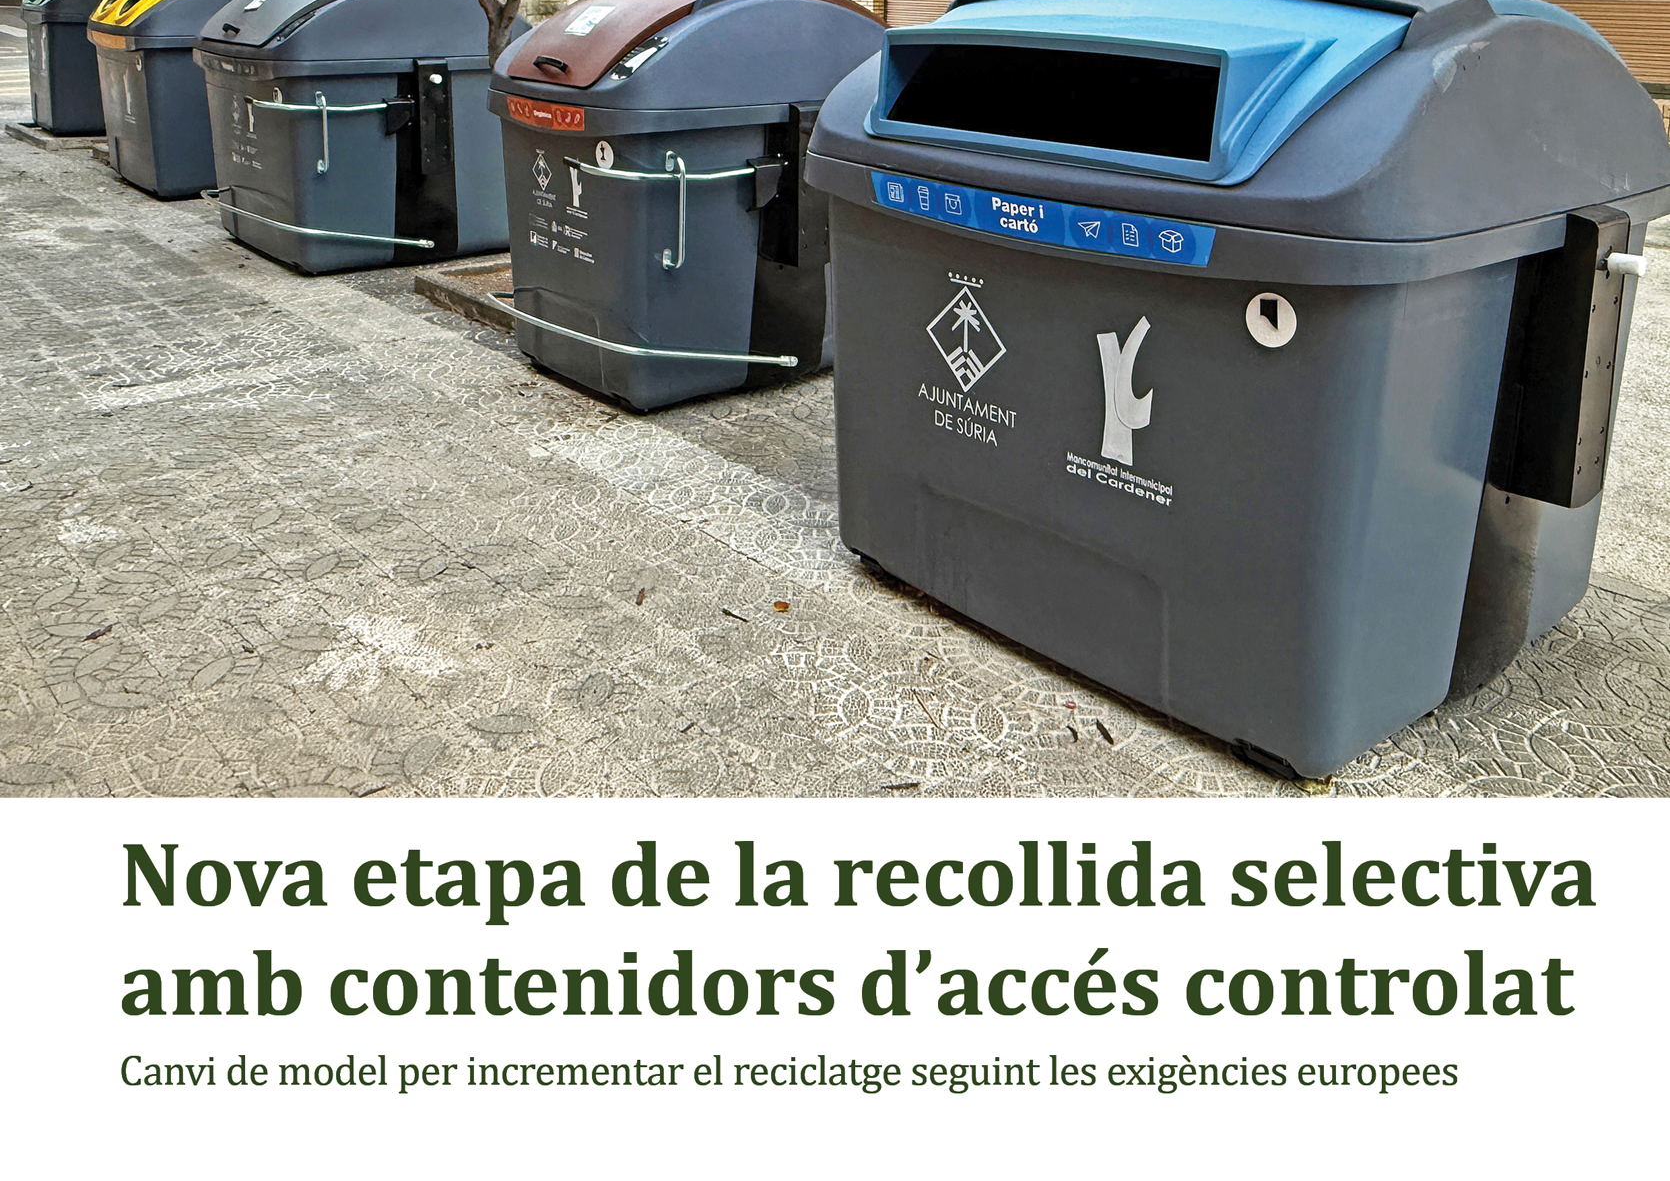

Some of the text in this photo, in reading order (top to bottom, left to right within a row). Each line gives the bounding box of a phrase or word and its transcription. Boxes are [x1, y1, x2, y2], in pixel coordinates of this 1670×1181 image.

[991, 196, 1044, 219] Paper i
[1000, 217, 1039, 234] cartó
[918, 383, 1017, 429] AJUNTAMENT
[934, 409, 998, 447] DE SÚRIA
[1066, 451, 1173, 496] Mancomunitat Intermunicipal
[1066, 463, 1173, 507] del Cardener
[123, 841, 1596, 925] Nova etapa de la recollida selectiva
[122, 948, 1575, 1016] amb contenidors d’accés controlat
[121, 1055, 1457, 1094] Canvi de model per incrementar el reciclatge seguint les exigències europees
